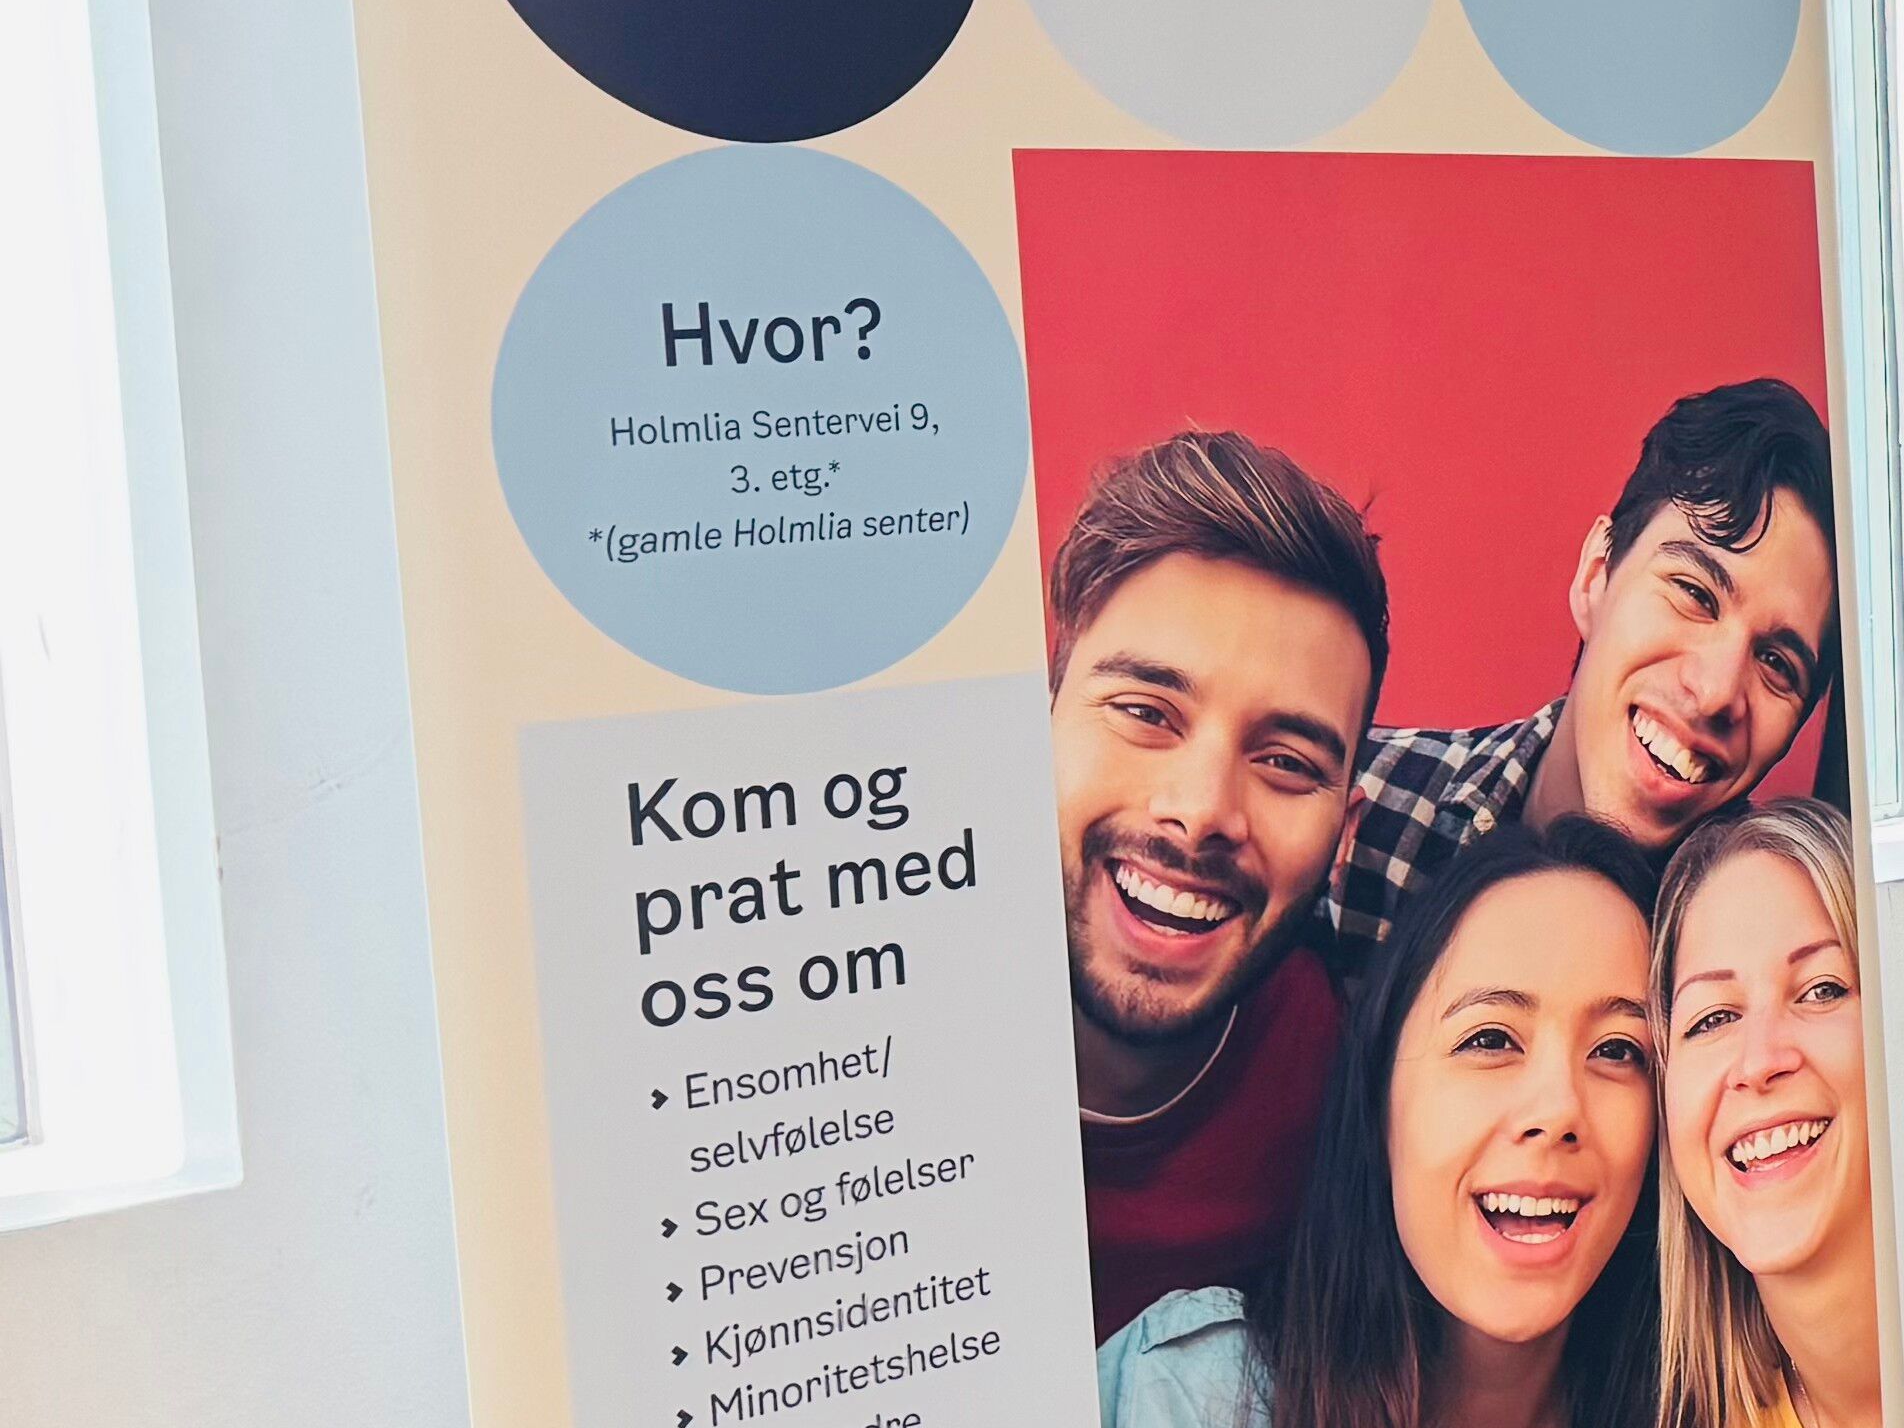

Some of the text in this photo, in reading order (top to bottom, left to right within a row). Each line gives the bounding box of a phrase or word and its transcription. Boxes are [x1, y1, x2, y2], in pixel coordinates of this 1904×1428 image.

[661, 297, 881, 367] Hvor?
[610, 402, 939, 447] Holmlia Sentervei 9,
[730, 464, 760, 494] 3.
[734, 511, 852, 548] Holmlia
[863, 500, 969, 537] senter)
[627, 766, 910, 846] Kom og
[635, 827, 976, 956] prat med
[641, 942, 906, 1028] oss om
[685, 1035, 892, 1110] Ensomhet/
[690, 1109, 895, 1173] selvfølelse
[695, 1149, 975, 1236] Sex og følelser
[700, 1230, 909, 1300] Prevensjon
[705, 1264, 991, 1368] Kjønnsidentitet
[710, 1329, 1001, 1427] Minoritetshelse
